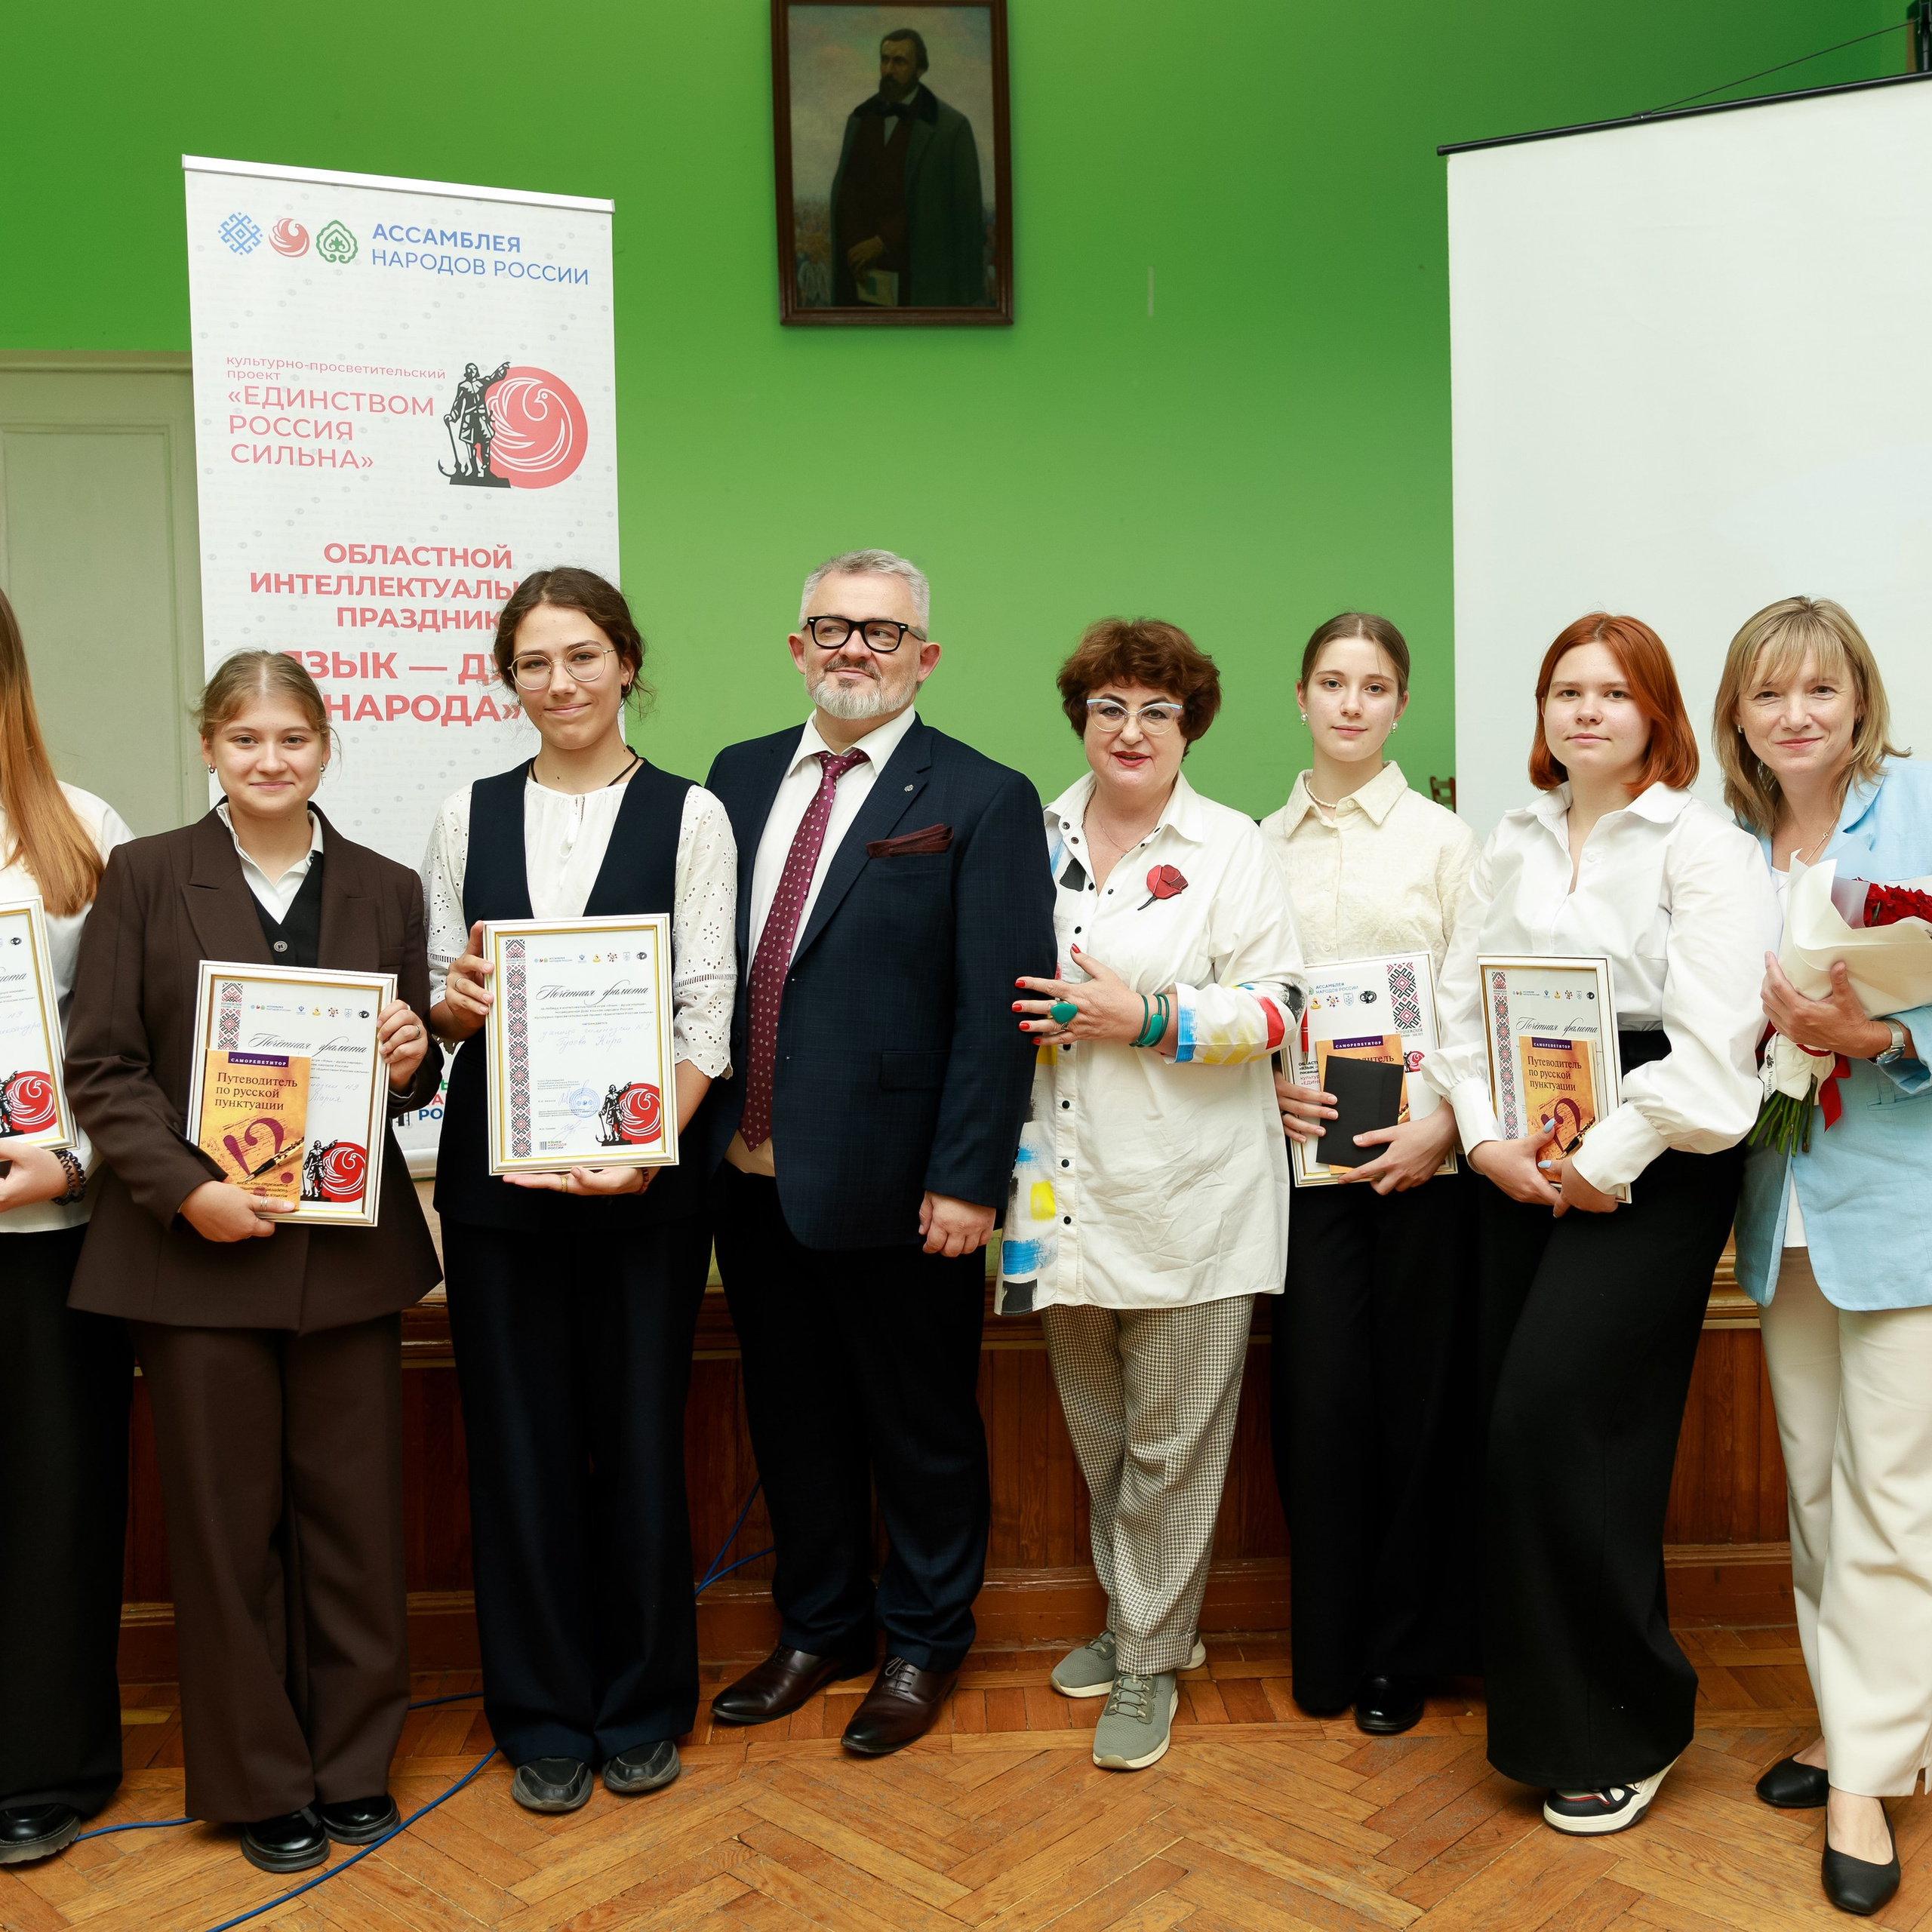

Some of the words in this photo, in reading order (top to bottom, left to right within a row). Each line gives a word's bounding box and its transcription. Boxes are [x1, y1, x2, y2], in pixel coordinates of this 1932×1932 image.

[372, 223, 521, 253] АССАМБЛЕЯ
[372, 249, 486, 275] НАРОДОВ
[494, 260, 589, 285] РОССИИ
[226, 356, 446, 380] культурно-просветительский
[227, 370, 281, 381] проект
[228, 385, 433, 417] «ЕДИНСТВОМ
[229, 414, 353, 441] РОССИЯ
[230, 443, 374, 469] СИЛЬНА»
[324, 543, 512, 569] ОБЛАСТНОЙ
[323, 694, 521, 727] НАРОДА»
[230, 1058, 287, 1066] САМОРЕПЕТИТОР
[1527, 1056, 1582, 1069] Путеводитель
[217, 1072, 298, 1088] Путеводитель
[1540, 1070, 1571, 1080] русской
[216, 1087, 230, 1095] по
[233, 1088, 280, 1098] русской
[1530, 1080, 1576, 1091] пунктуации
[214, 1098, 285, 1111] пунктуации
